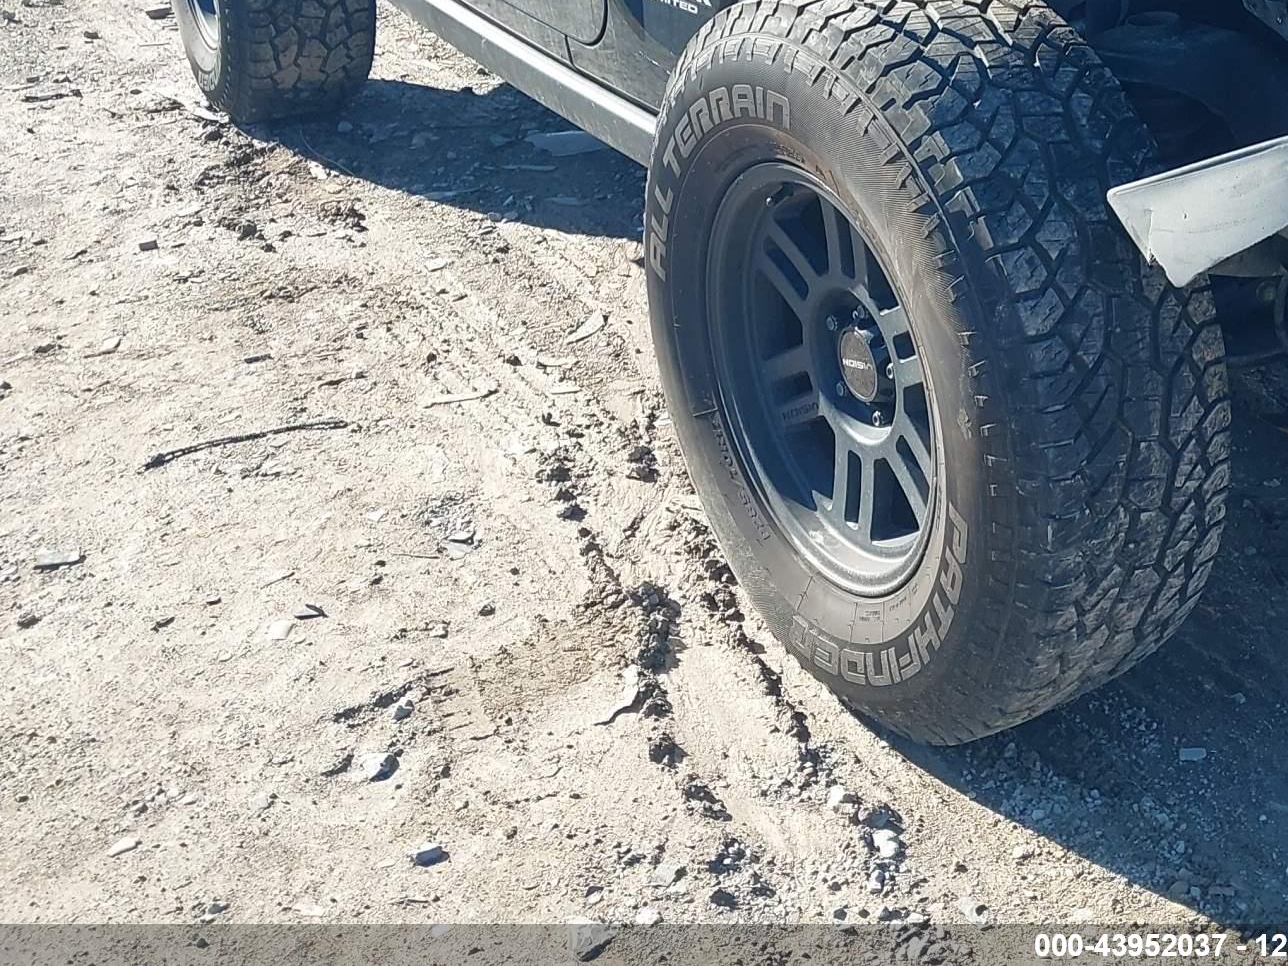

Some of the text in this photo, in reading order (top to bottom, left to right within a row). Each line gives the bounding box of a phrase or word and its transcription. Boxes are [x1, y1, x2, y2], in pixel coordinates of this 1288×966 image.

[649, 184, 674, 283] ALL
[662, 83, 792, 178] TERRAIN
[842, 357, 873, 371] VISION
[790, 501, 968, 687] PATHFINDER
